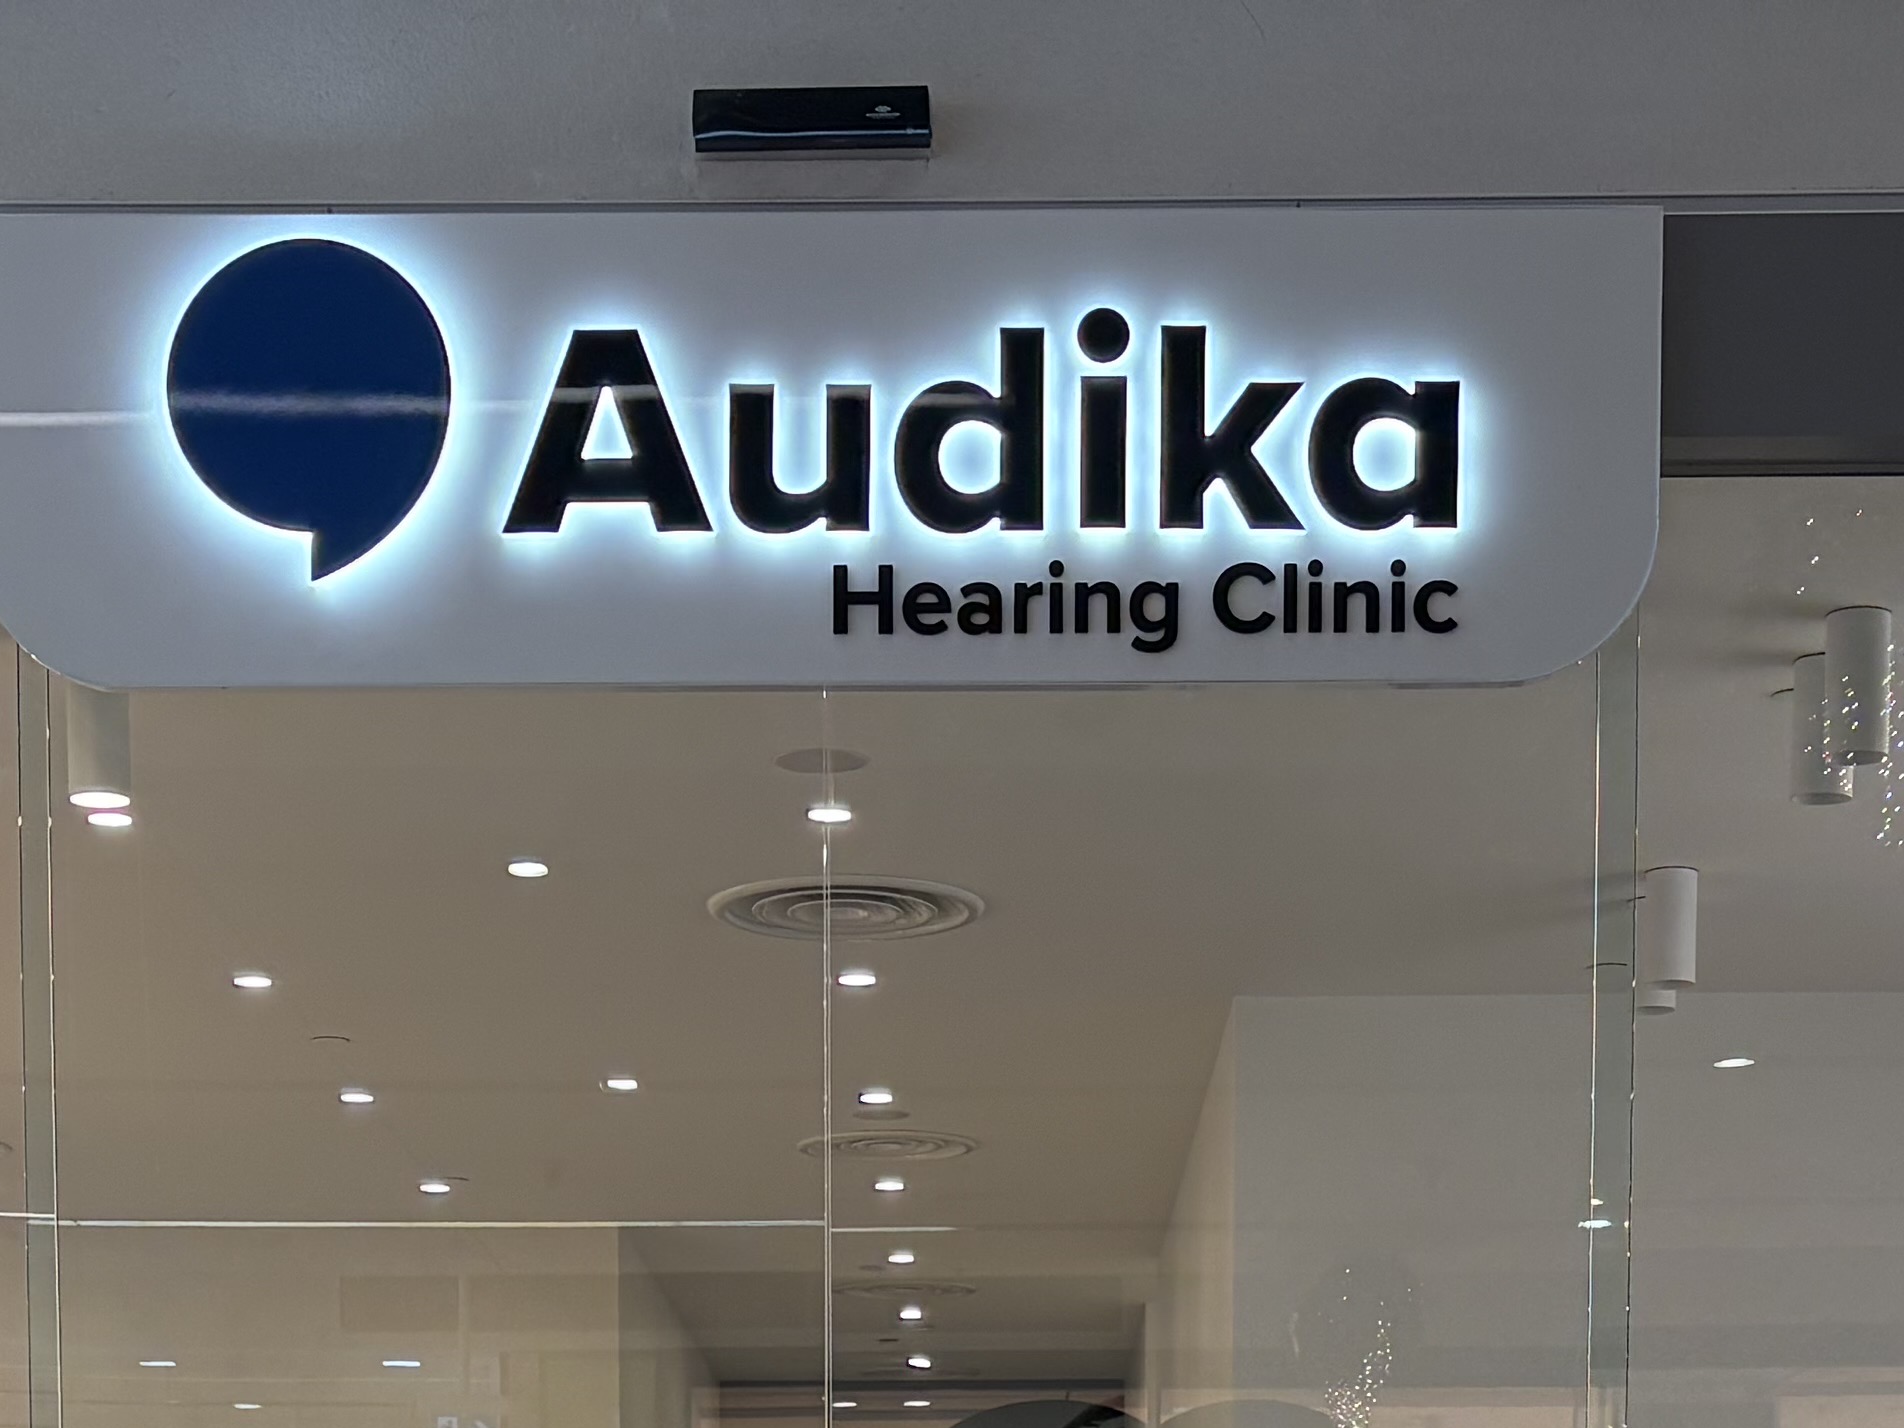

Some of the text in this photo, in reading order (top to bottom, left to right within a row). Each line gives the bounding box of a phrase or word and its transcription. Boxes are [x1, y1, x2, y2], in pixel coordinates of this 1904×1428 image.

[502, 307, 1463, 535] Audika
[831, 561, 1460, 652] Hearing Clinic
